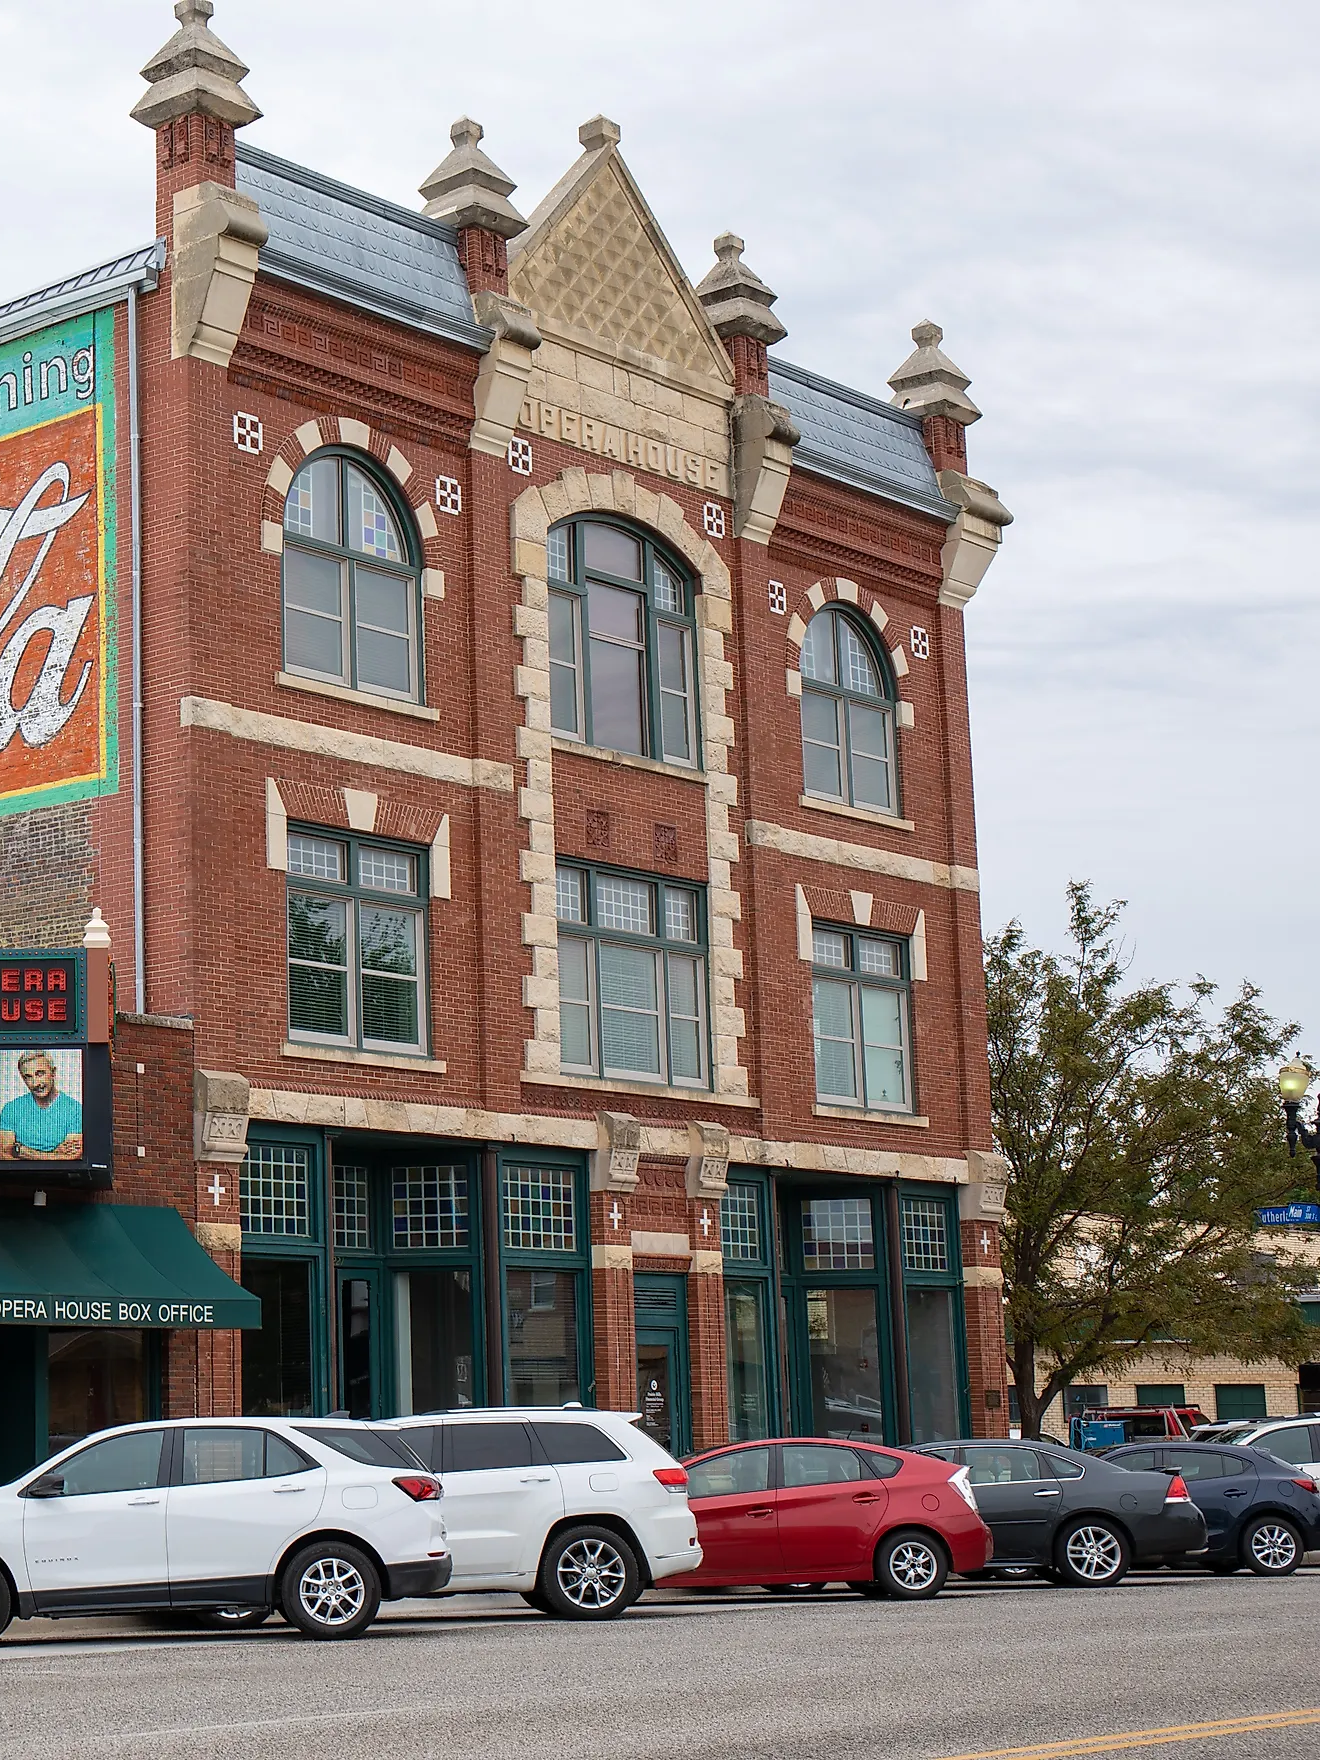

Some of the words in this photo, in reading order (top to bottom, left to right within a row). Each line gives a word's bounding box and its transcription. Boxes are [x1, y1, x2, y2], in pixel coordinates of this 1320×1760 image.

[625, 432, 721, 491] HOUSE
[1261, 1210, 1291, 1223] utherl
[1288, 1205, 1303, 1218] Main
[54, 1301, 112, 1321] HOUSE
[118, 1303, 152, 1322] BOX
[158, 1304, 214, 1323] OFFICE
